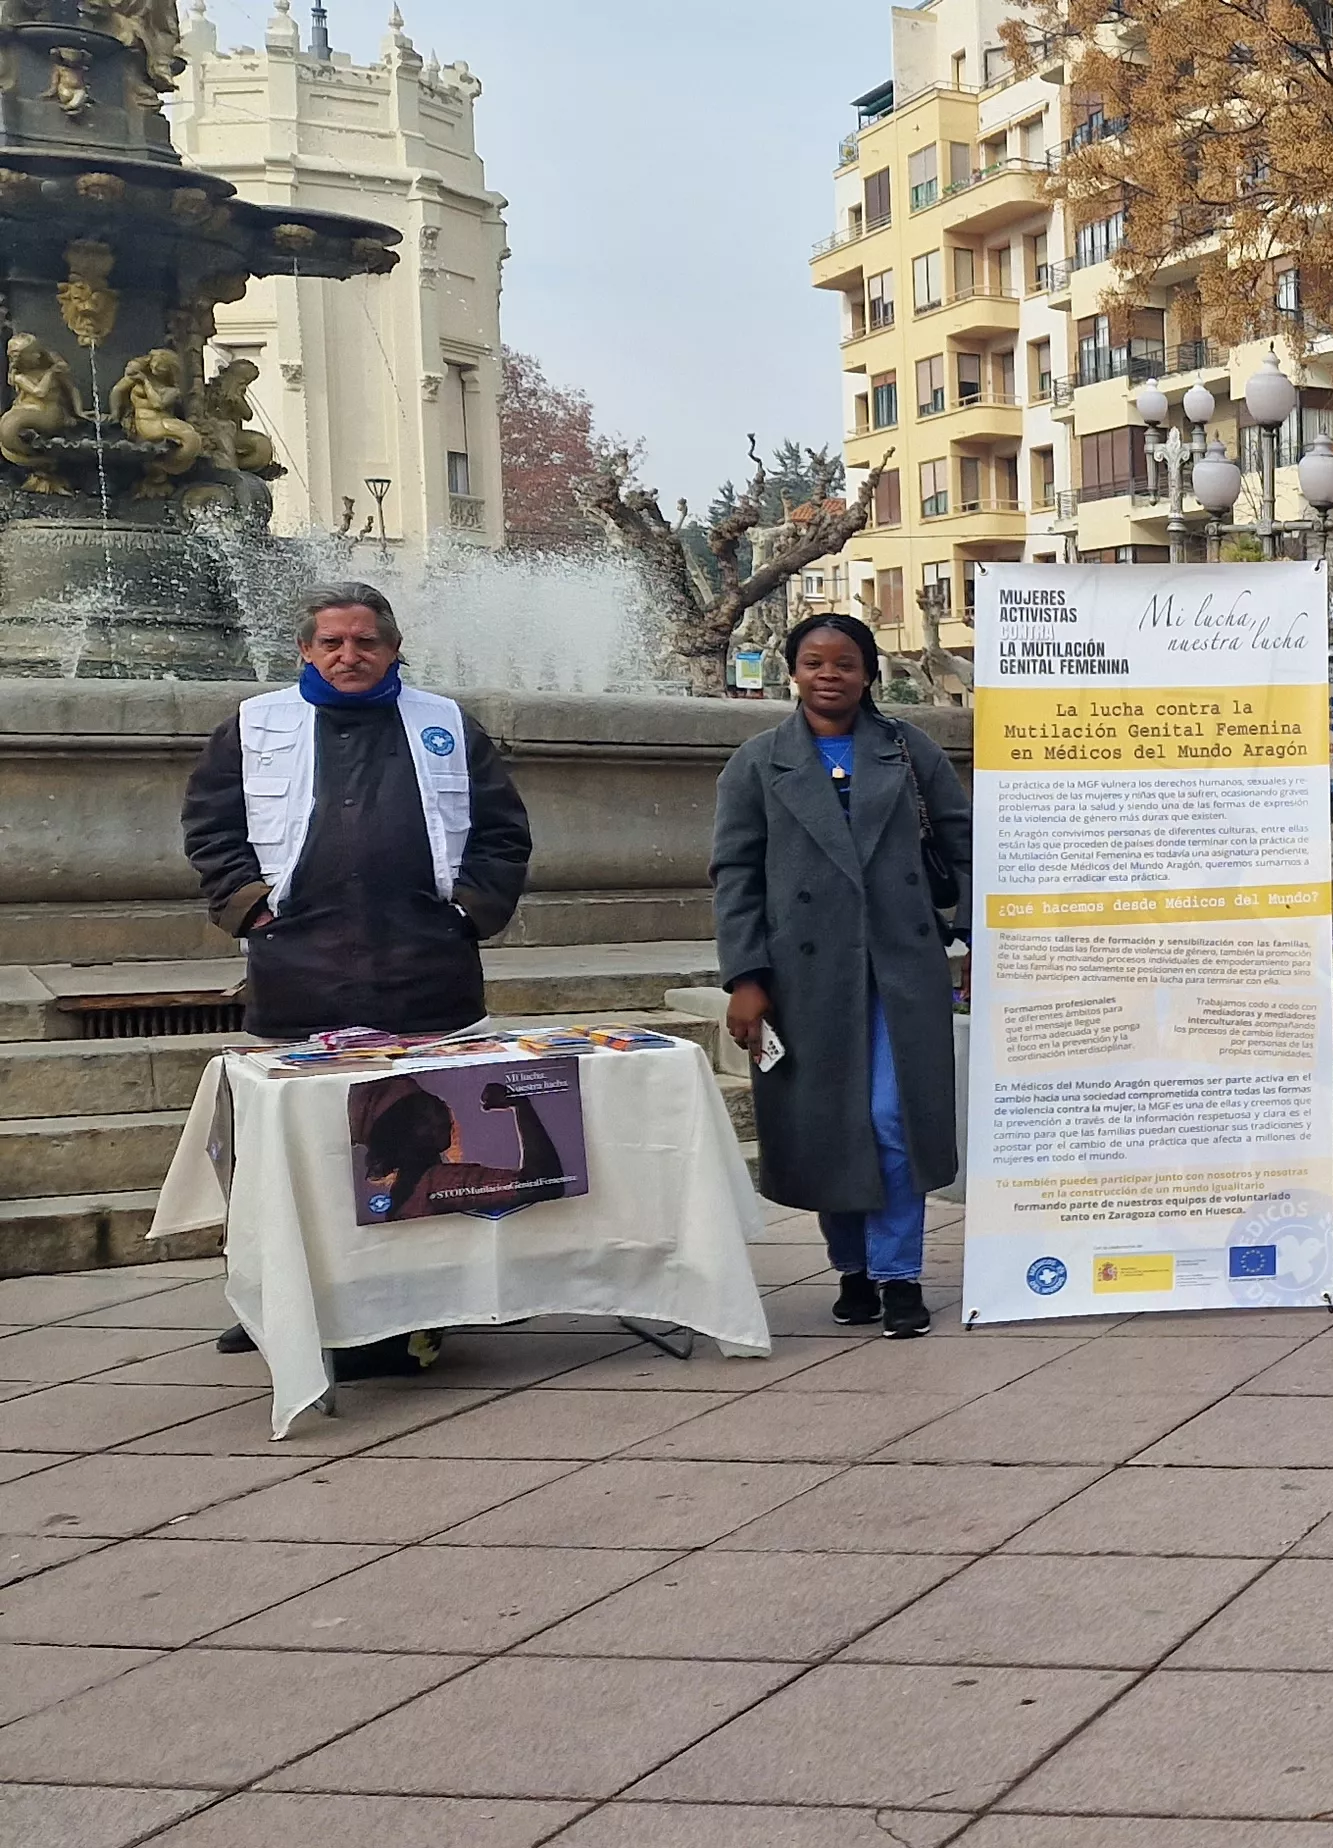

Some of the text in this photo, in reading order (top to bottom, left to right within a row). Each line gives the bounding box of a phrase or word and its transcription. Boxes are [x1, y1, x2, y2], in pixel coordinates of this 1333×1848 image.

[999, 589, 1066, 606] MUJERES
[999, 606, 1077, 623] ACTIVISTAS
[1139, 590, 1255, 632] Mi lucha,
[1000, 624, 1055, 640] CONTRA
[1167, 612, 1308, 650] nuestra lucha
[999, 639, 1105, 658] LA MUTILACIÓN
[999, 659, 1130, 675] GENITAL FEMENINA
[1056, 700, 1252, 718] La lucha contra la
[1004, 722, 1301, 739] Mutilación Genital Femenina
[1010, 742, 1307, 760] en Médicos del Mundo Aragón
[998, 890, 1319, 917] ¿Qué hacemos desde Médicos del Mundo?
[506, 1084, 543, 1094] Nuestra
[1013, 1191, 1290, 1211] formando parte de nuestros equipos de voluntariado
[1060, 1213, 1089, 1221] tanto
[1108, 1211, 1155, 1220] Zaragoza
[1158, 1209, 1188, 1217] como
[1203, 1206, 1245, 1215] Huesca.
